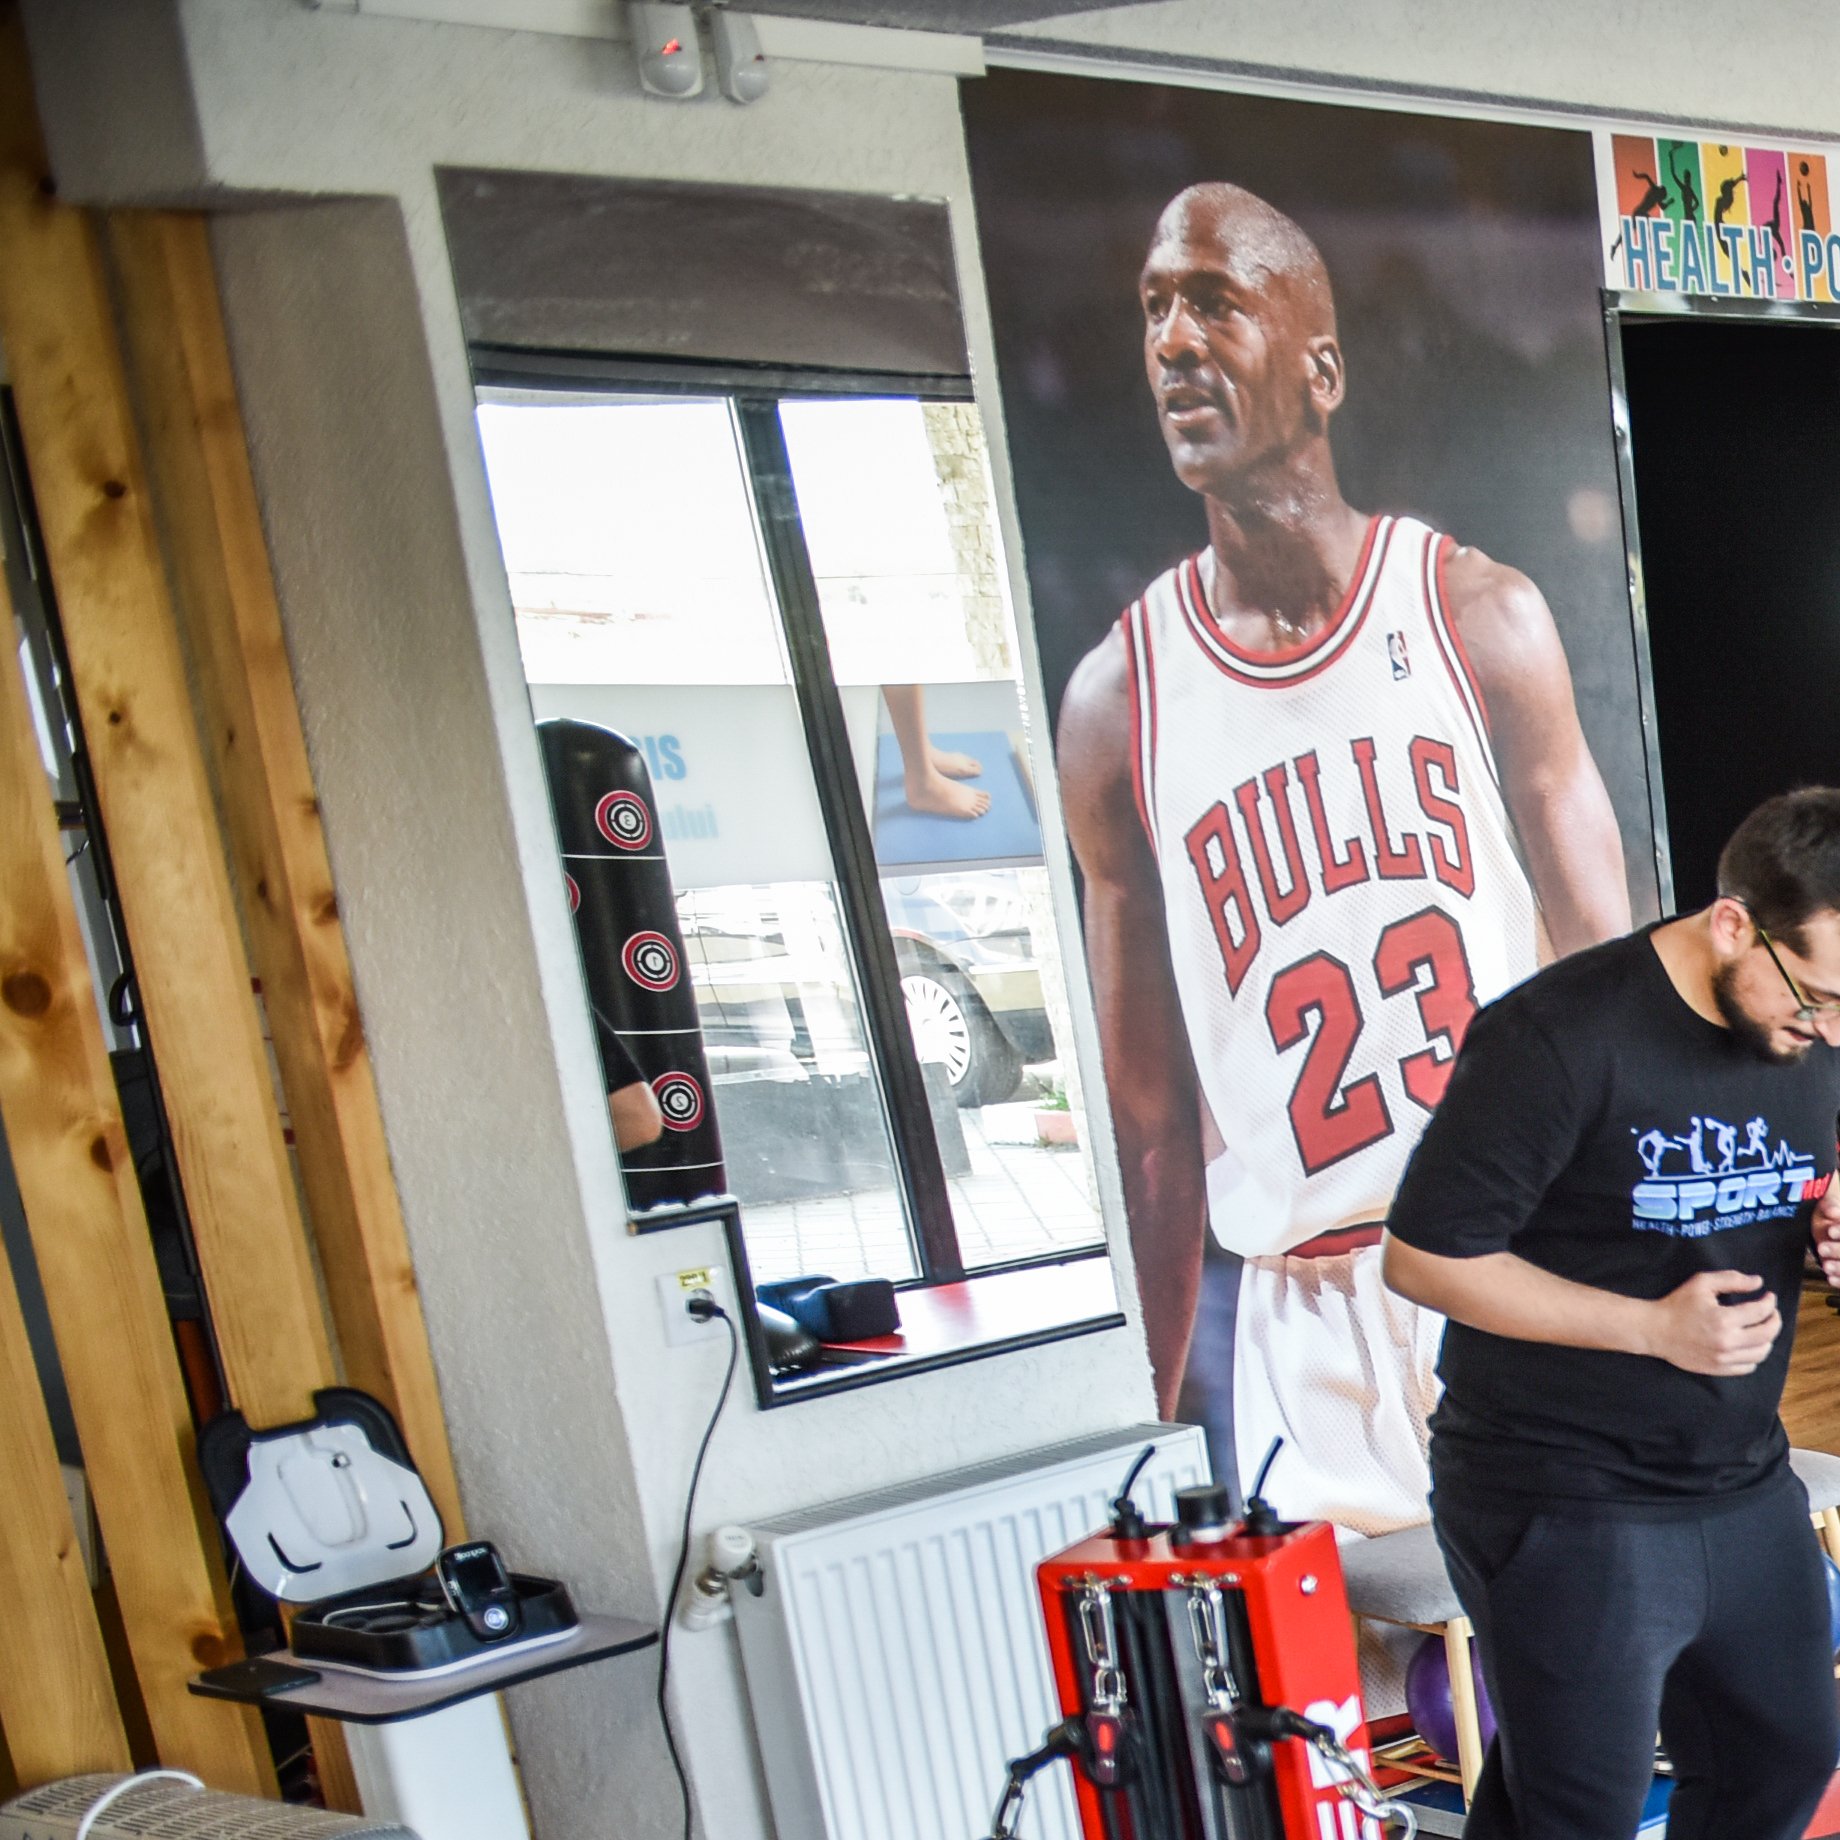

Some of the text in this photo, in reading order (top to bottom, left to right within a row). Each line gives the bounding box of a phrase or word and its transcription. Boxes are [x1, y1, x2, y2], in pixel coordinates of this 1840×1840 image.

[1623, 216, 1777, 298] HEALTH
[1184, 735, 1475, 1001] BULLS
[1265, 904, 1481, 1177] 23
[1632, 1167, 1815, 1220] SPORT
